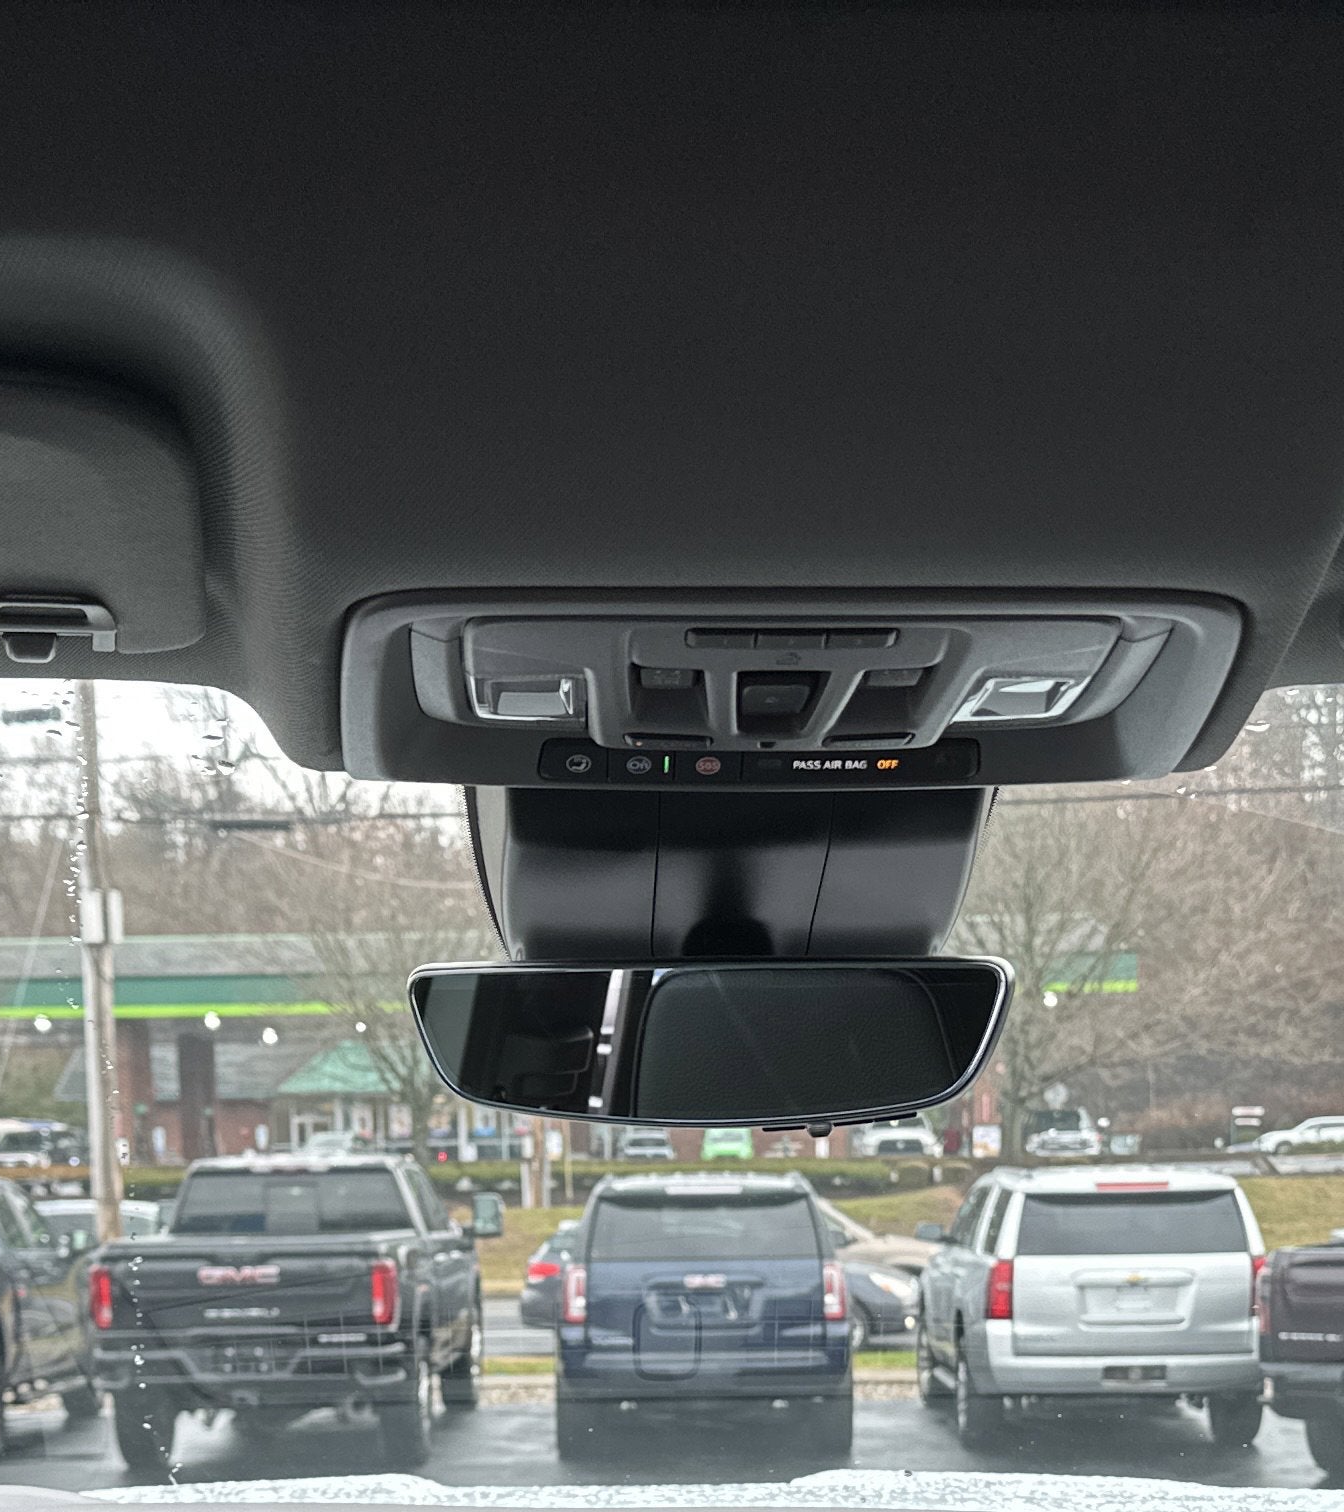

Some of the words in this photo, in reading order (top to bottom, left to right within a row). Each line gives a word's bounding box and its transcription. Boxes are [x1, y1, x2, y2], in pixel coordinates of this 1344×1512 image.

[793, 759, 821, 770] PASS
[823, 758, 842, 770] AIR
[845, 758, 867, 770] BAG
[877, 758, 899, 770] OFF
[198, 1264, 281, 1286] GMC
